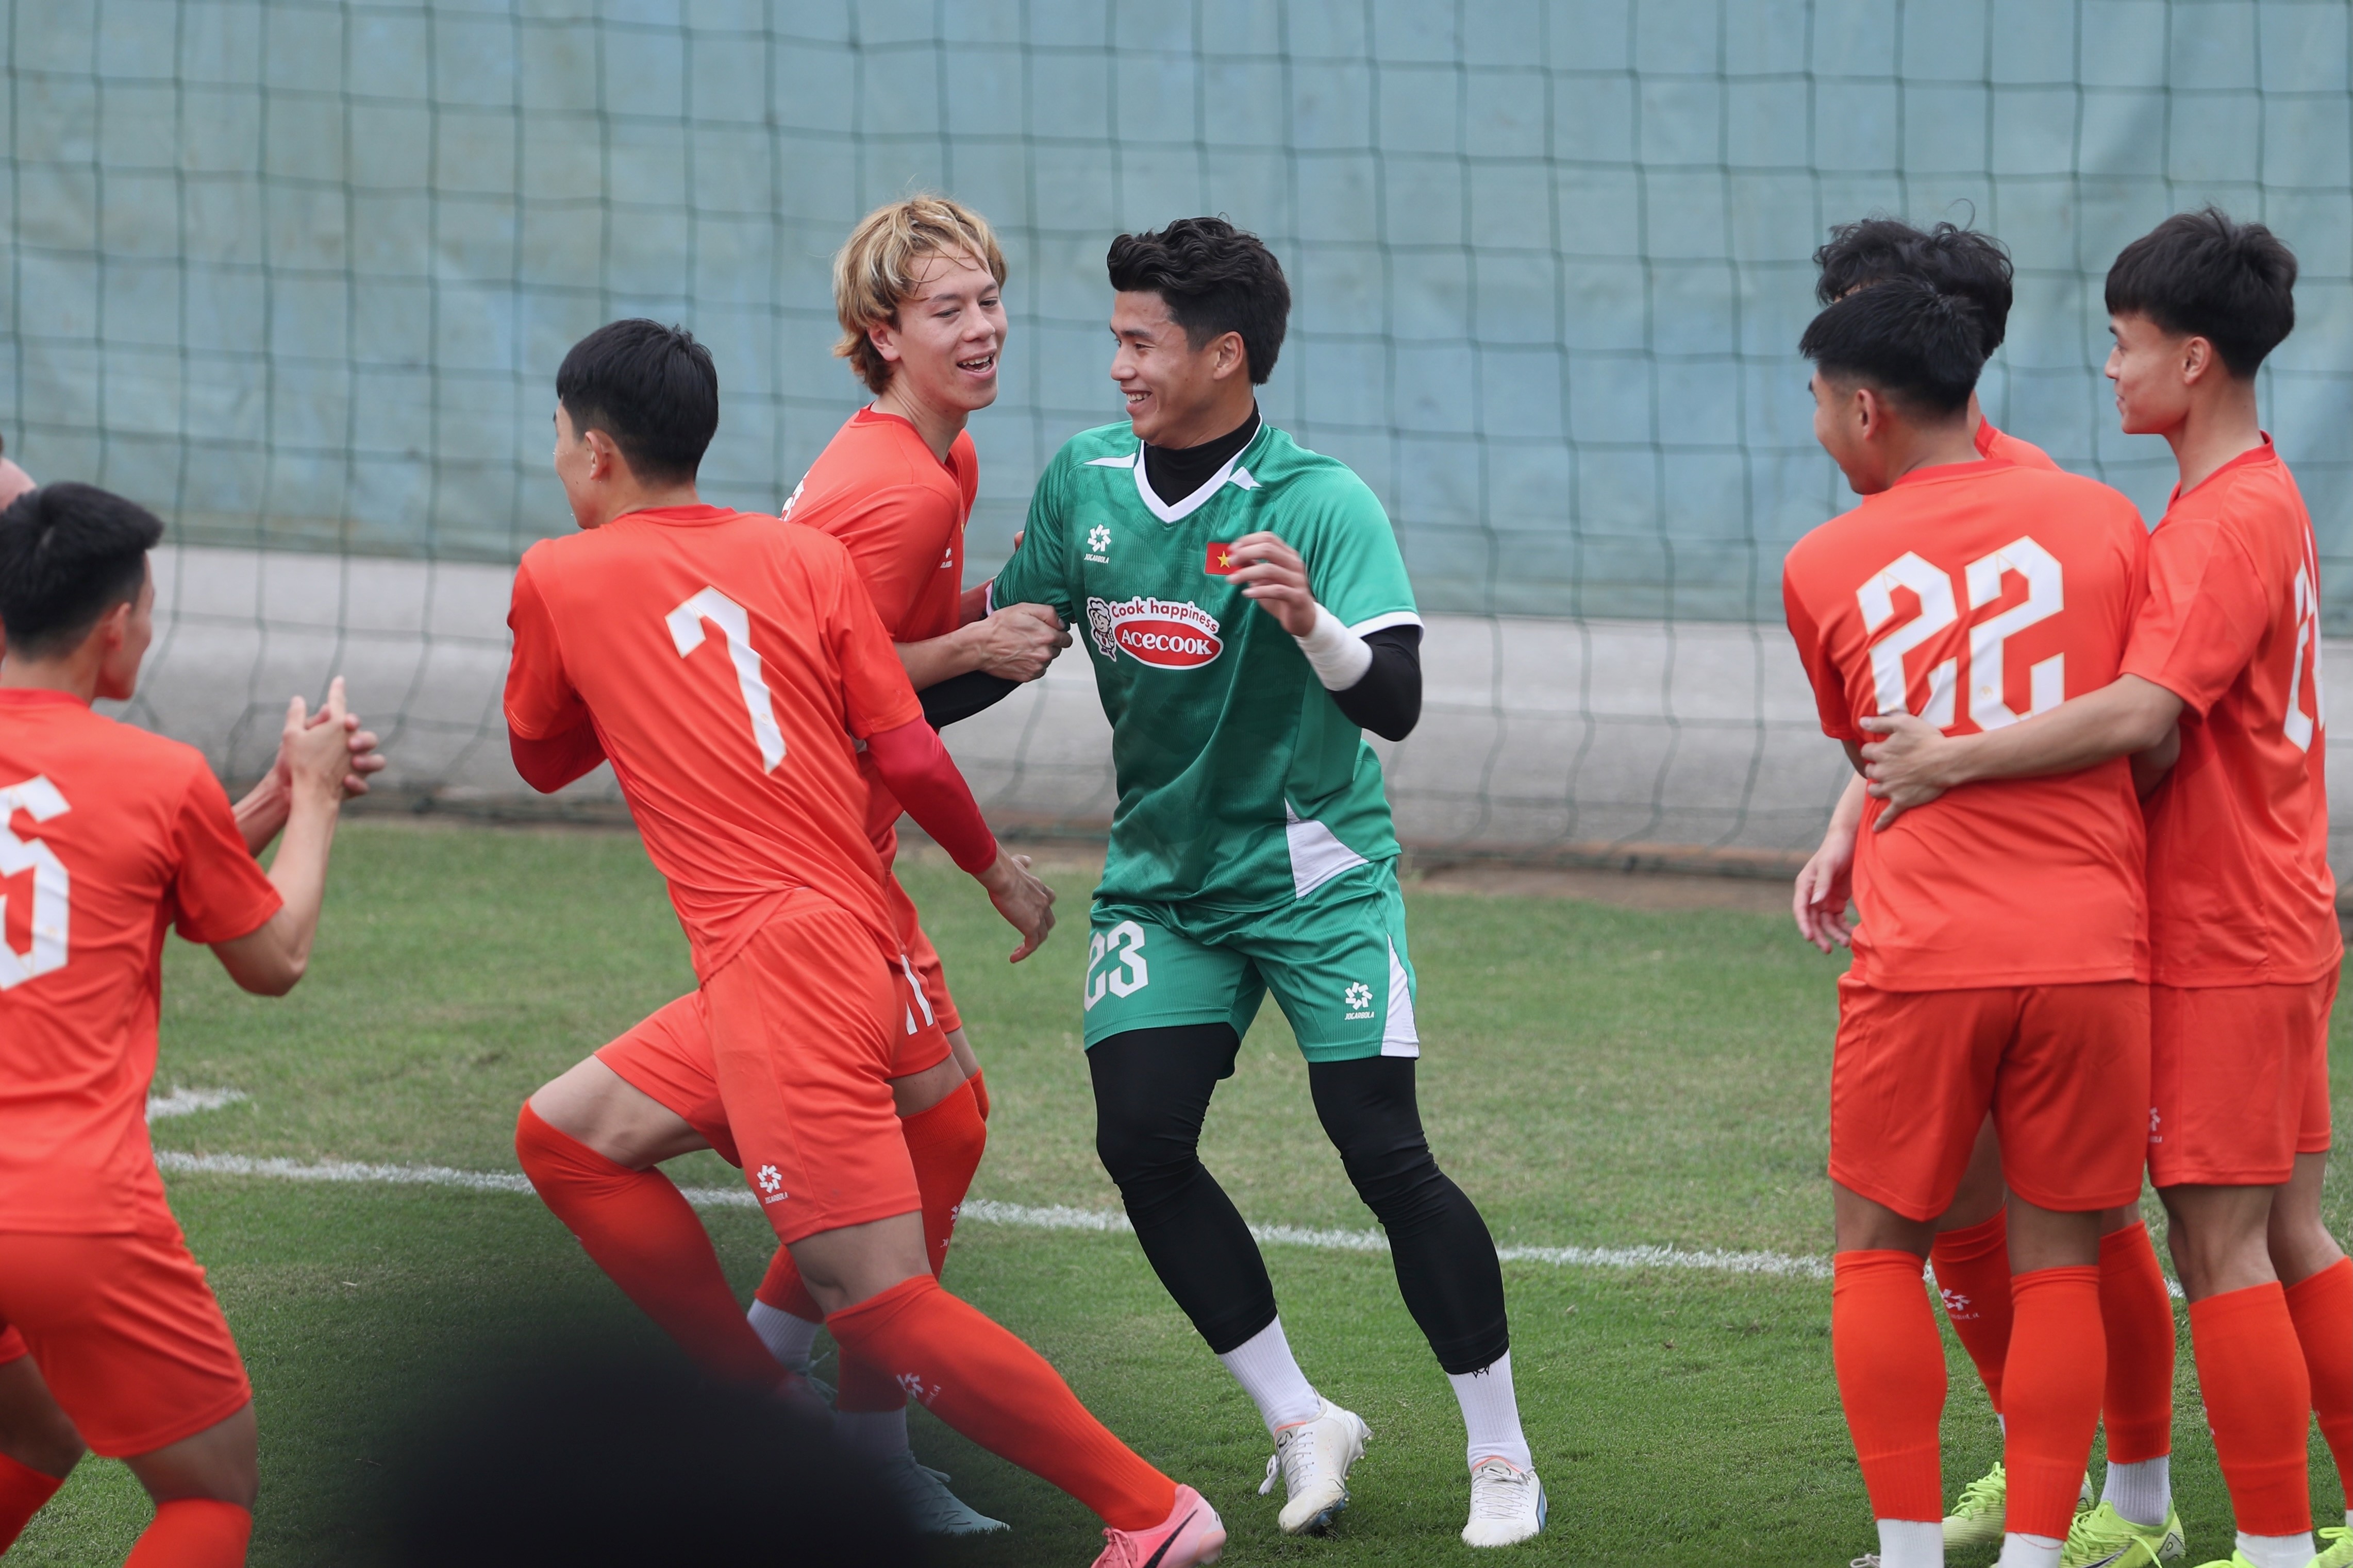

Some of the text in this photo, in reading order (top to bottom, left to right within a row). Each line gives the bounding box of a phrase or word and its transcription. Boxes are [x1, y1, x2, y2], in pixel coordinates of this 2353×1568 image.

[664, 584, 788, 775] 7
[1111, 600, 1217, 632] Cook happiness
[1856, 535, 2065, 732] 22
[1083, 920, 1149, 1013] 23
